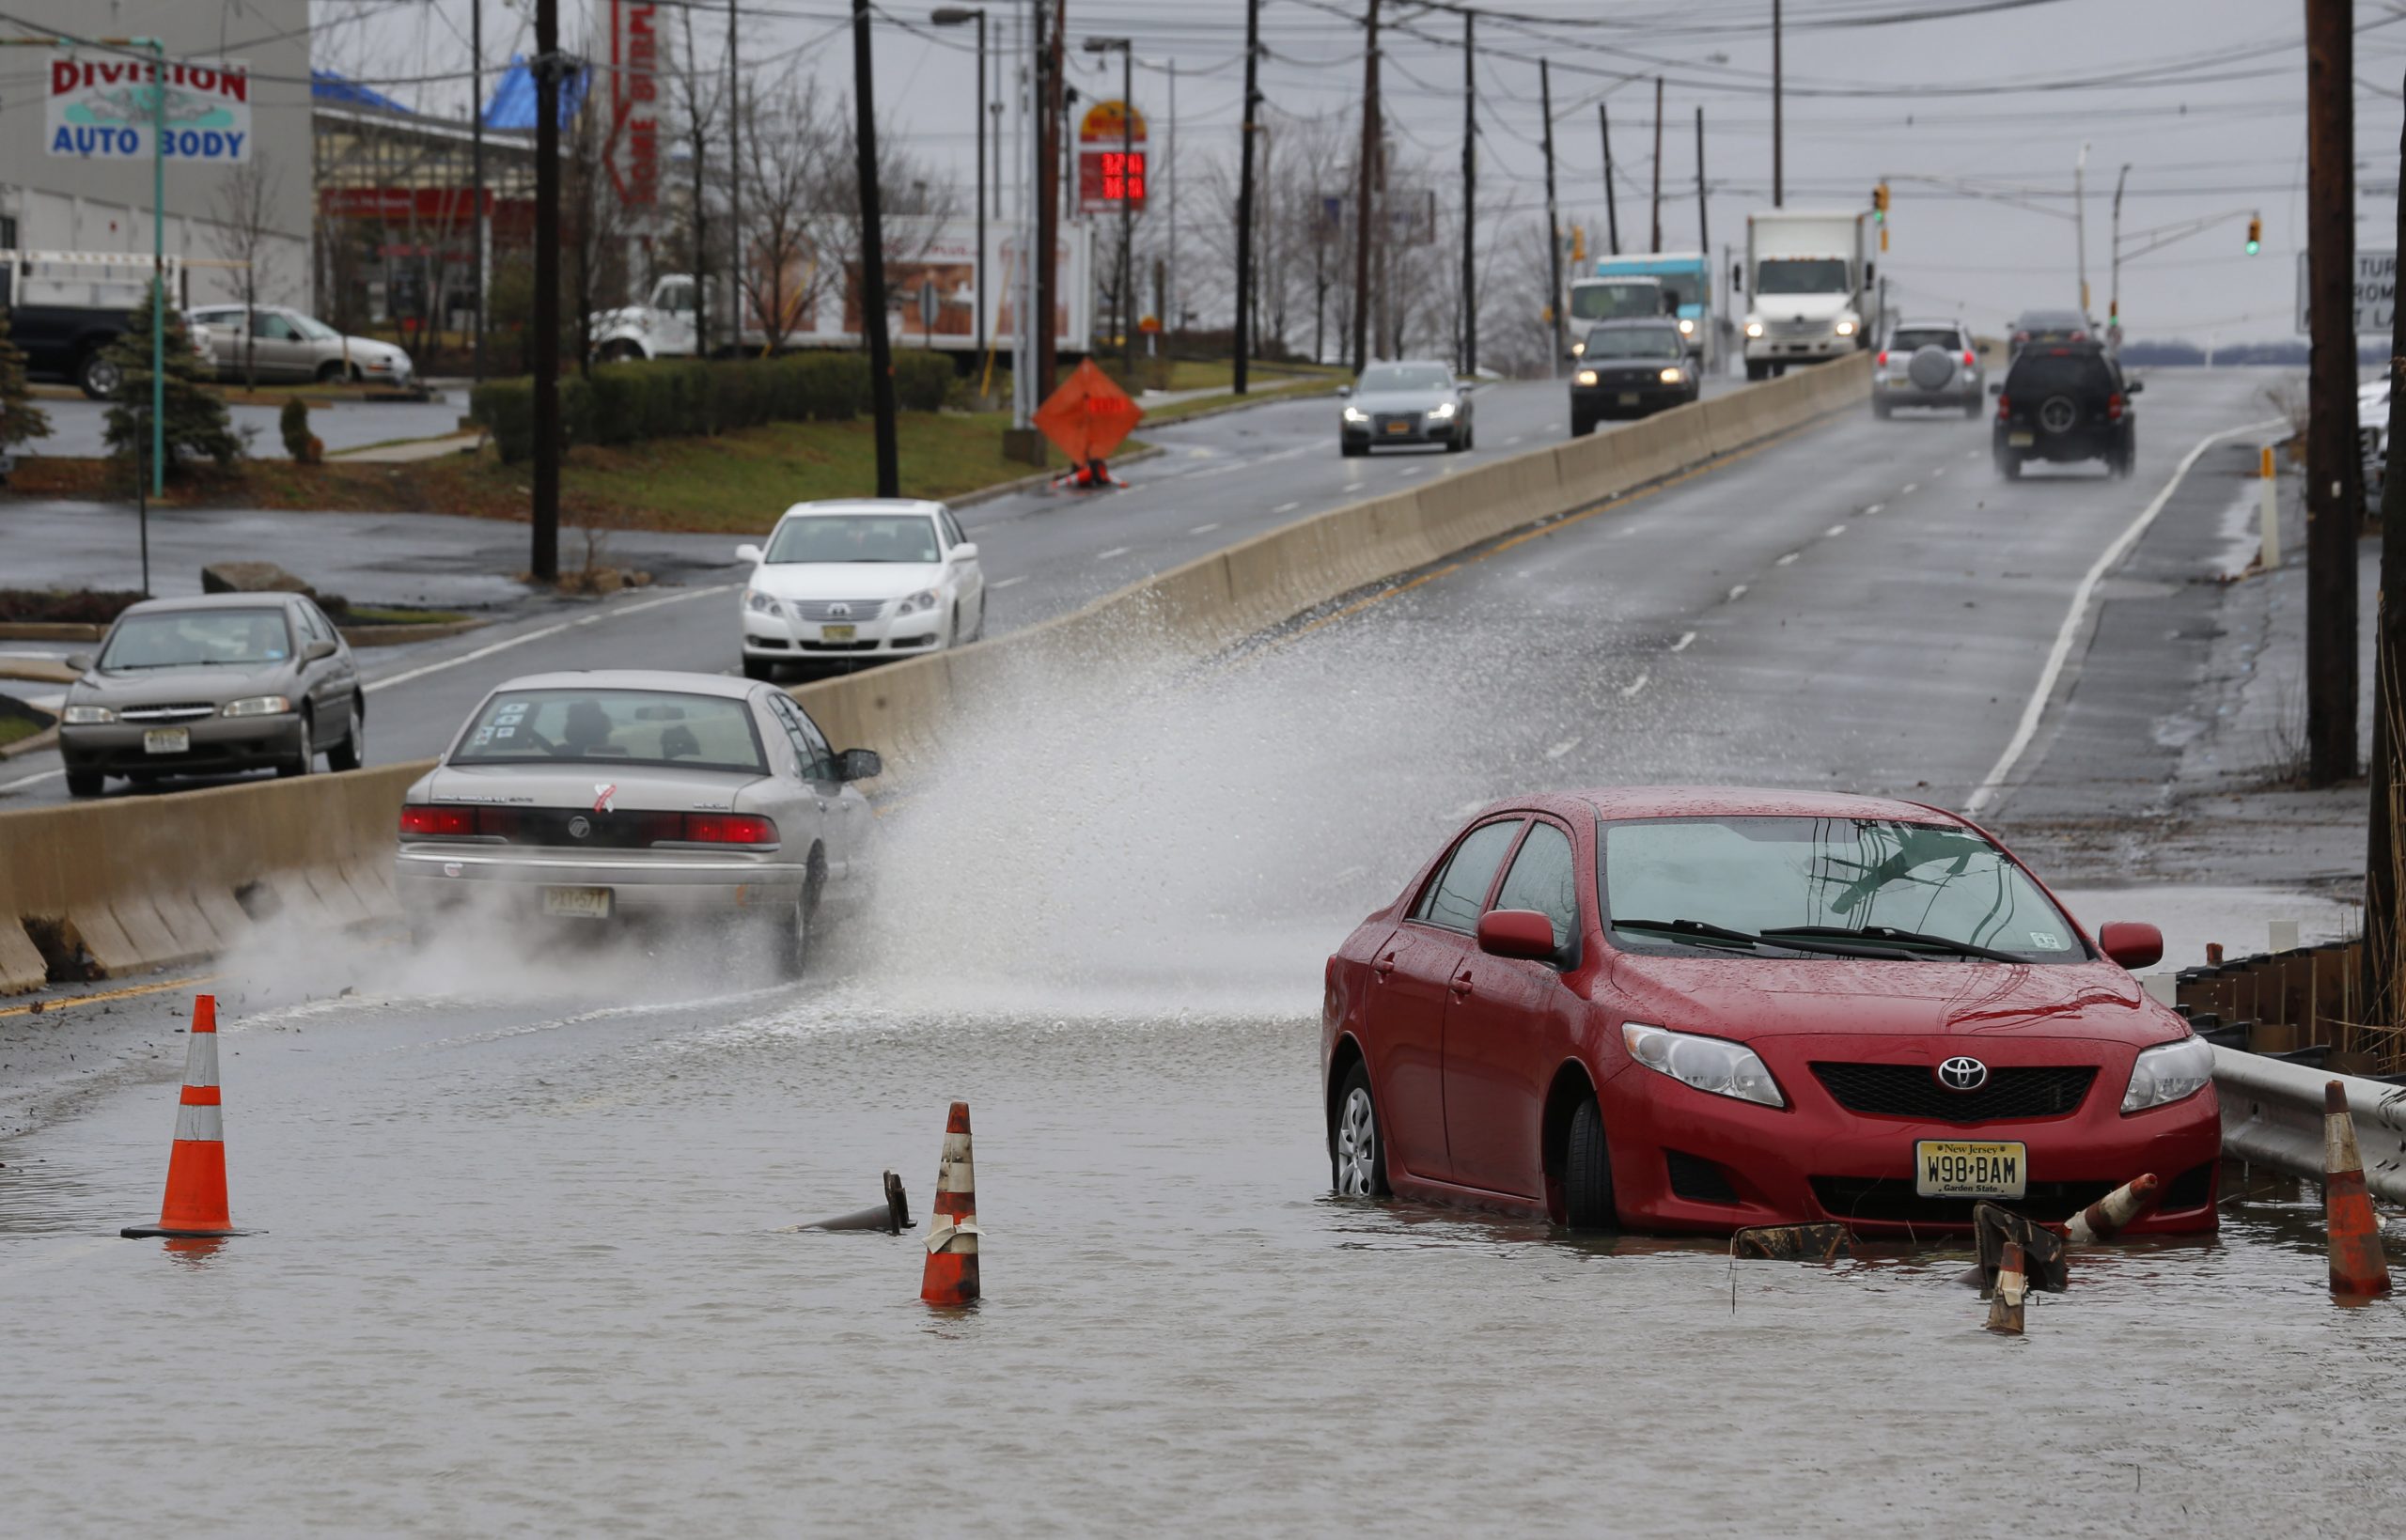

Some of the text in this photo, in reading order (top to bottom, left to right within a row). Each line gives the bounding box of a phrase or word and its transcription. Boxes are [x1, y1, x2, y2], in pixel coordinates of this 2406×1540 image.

[53, 61, 246, 102] DIVISION
[53, 127, 243, 158] AUTO BODY
[631, 119, 655, 203] HOME
[2360, 257, 2397, 278] TUR
[2353, 283, 2395, 303] ROM
[1944, 1143, 1998, 1156] New Jersey
[1944, 1184, 1998, 1192] Garden State
